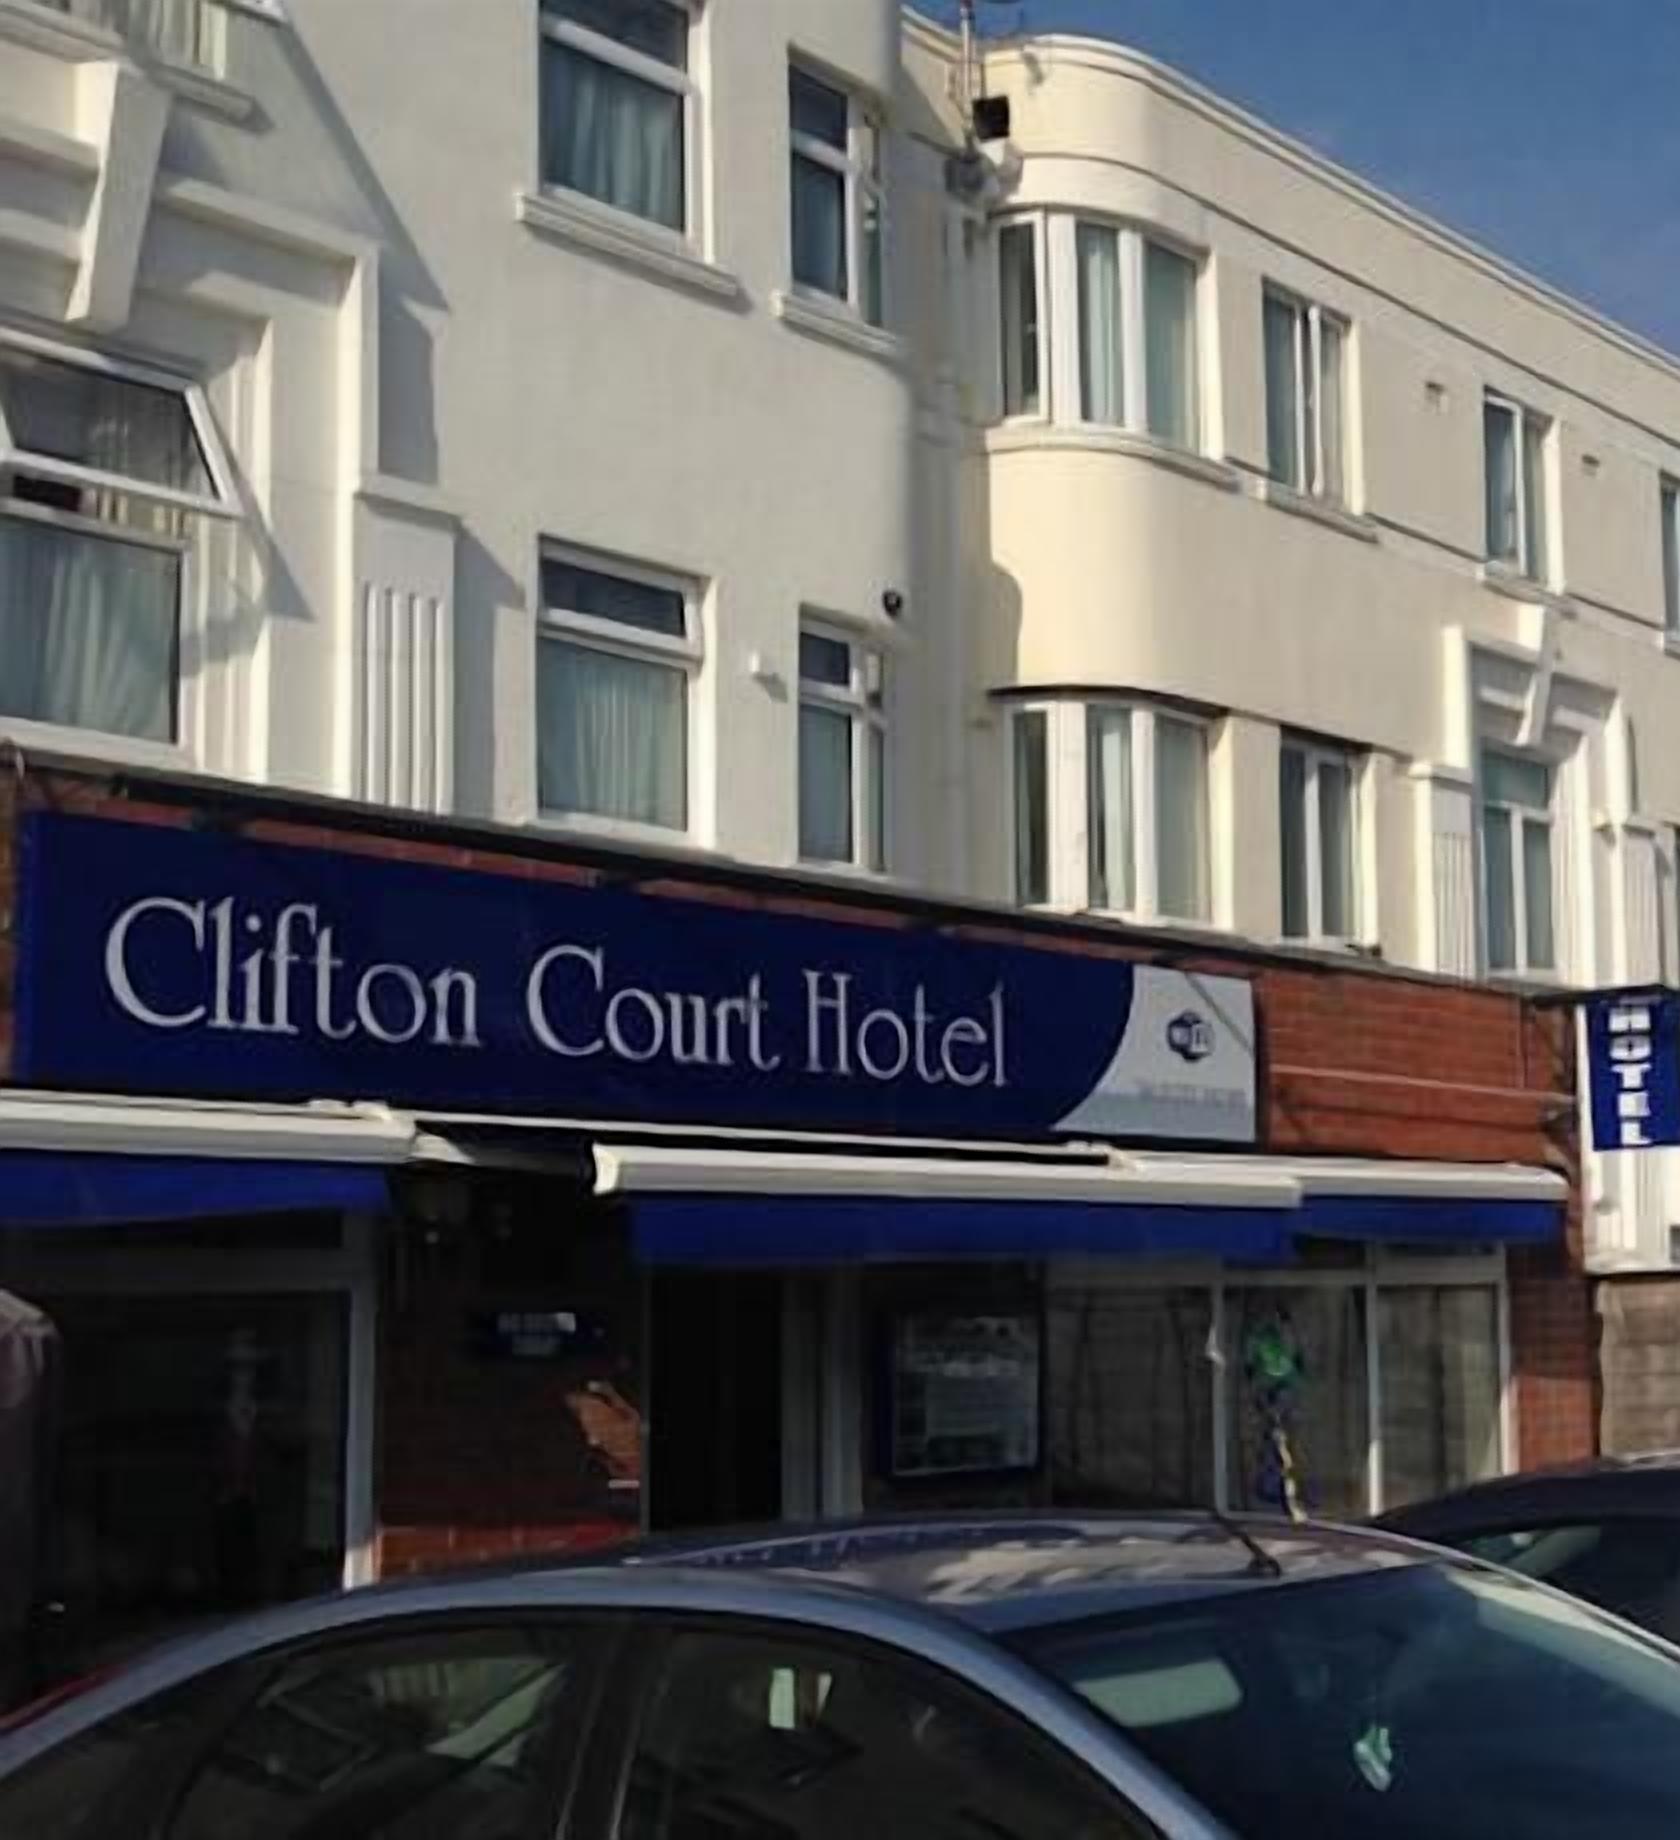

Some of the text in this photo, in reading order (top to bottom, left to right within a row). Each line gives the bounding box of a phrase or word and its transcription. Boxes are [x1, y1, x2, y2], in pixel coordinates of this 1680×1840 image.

[105, 896, 1007, 1086] Clifton Court Hotel
[1608, 1005, 1652, 1145] HOTEL
